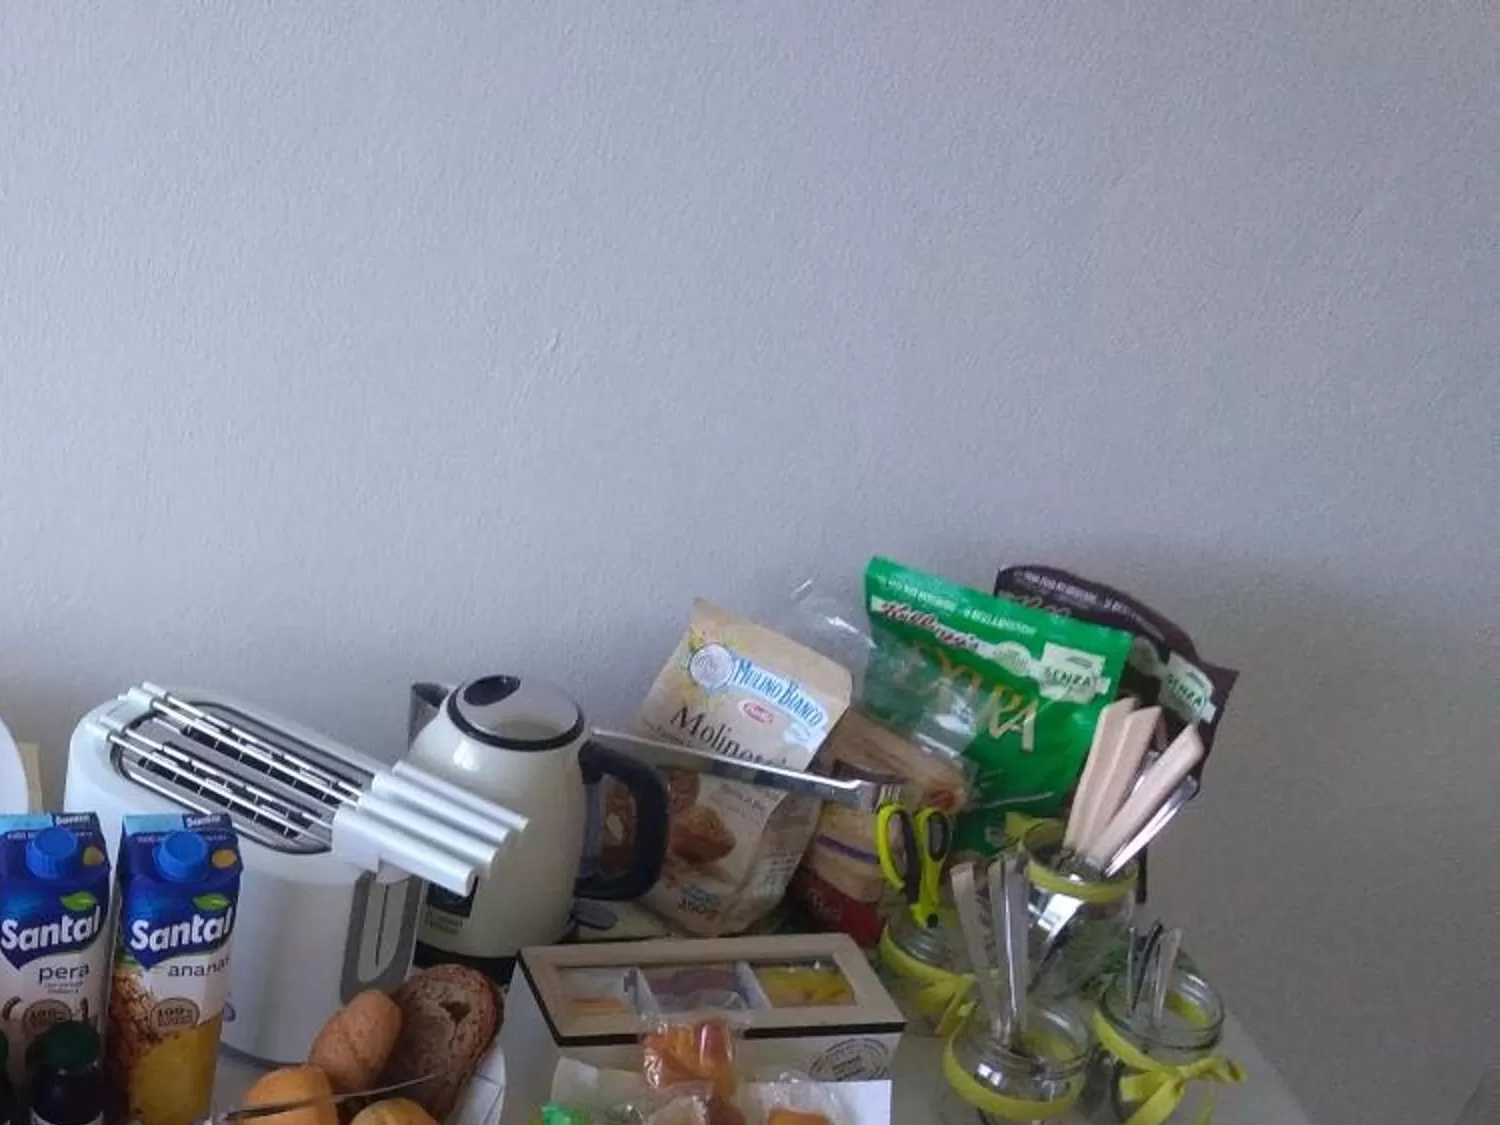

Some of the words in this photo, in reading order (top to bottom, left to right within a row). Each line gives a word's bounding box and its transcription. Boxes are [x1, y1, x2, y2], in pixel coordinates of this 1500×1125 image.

[0, 904, 101, 951] Santal
[129, 903, 234, 952] Santal
[39, 962, 91, 985] pera
